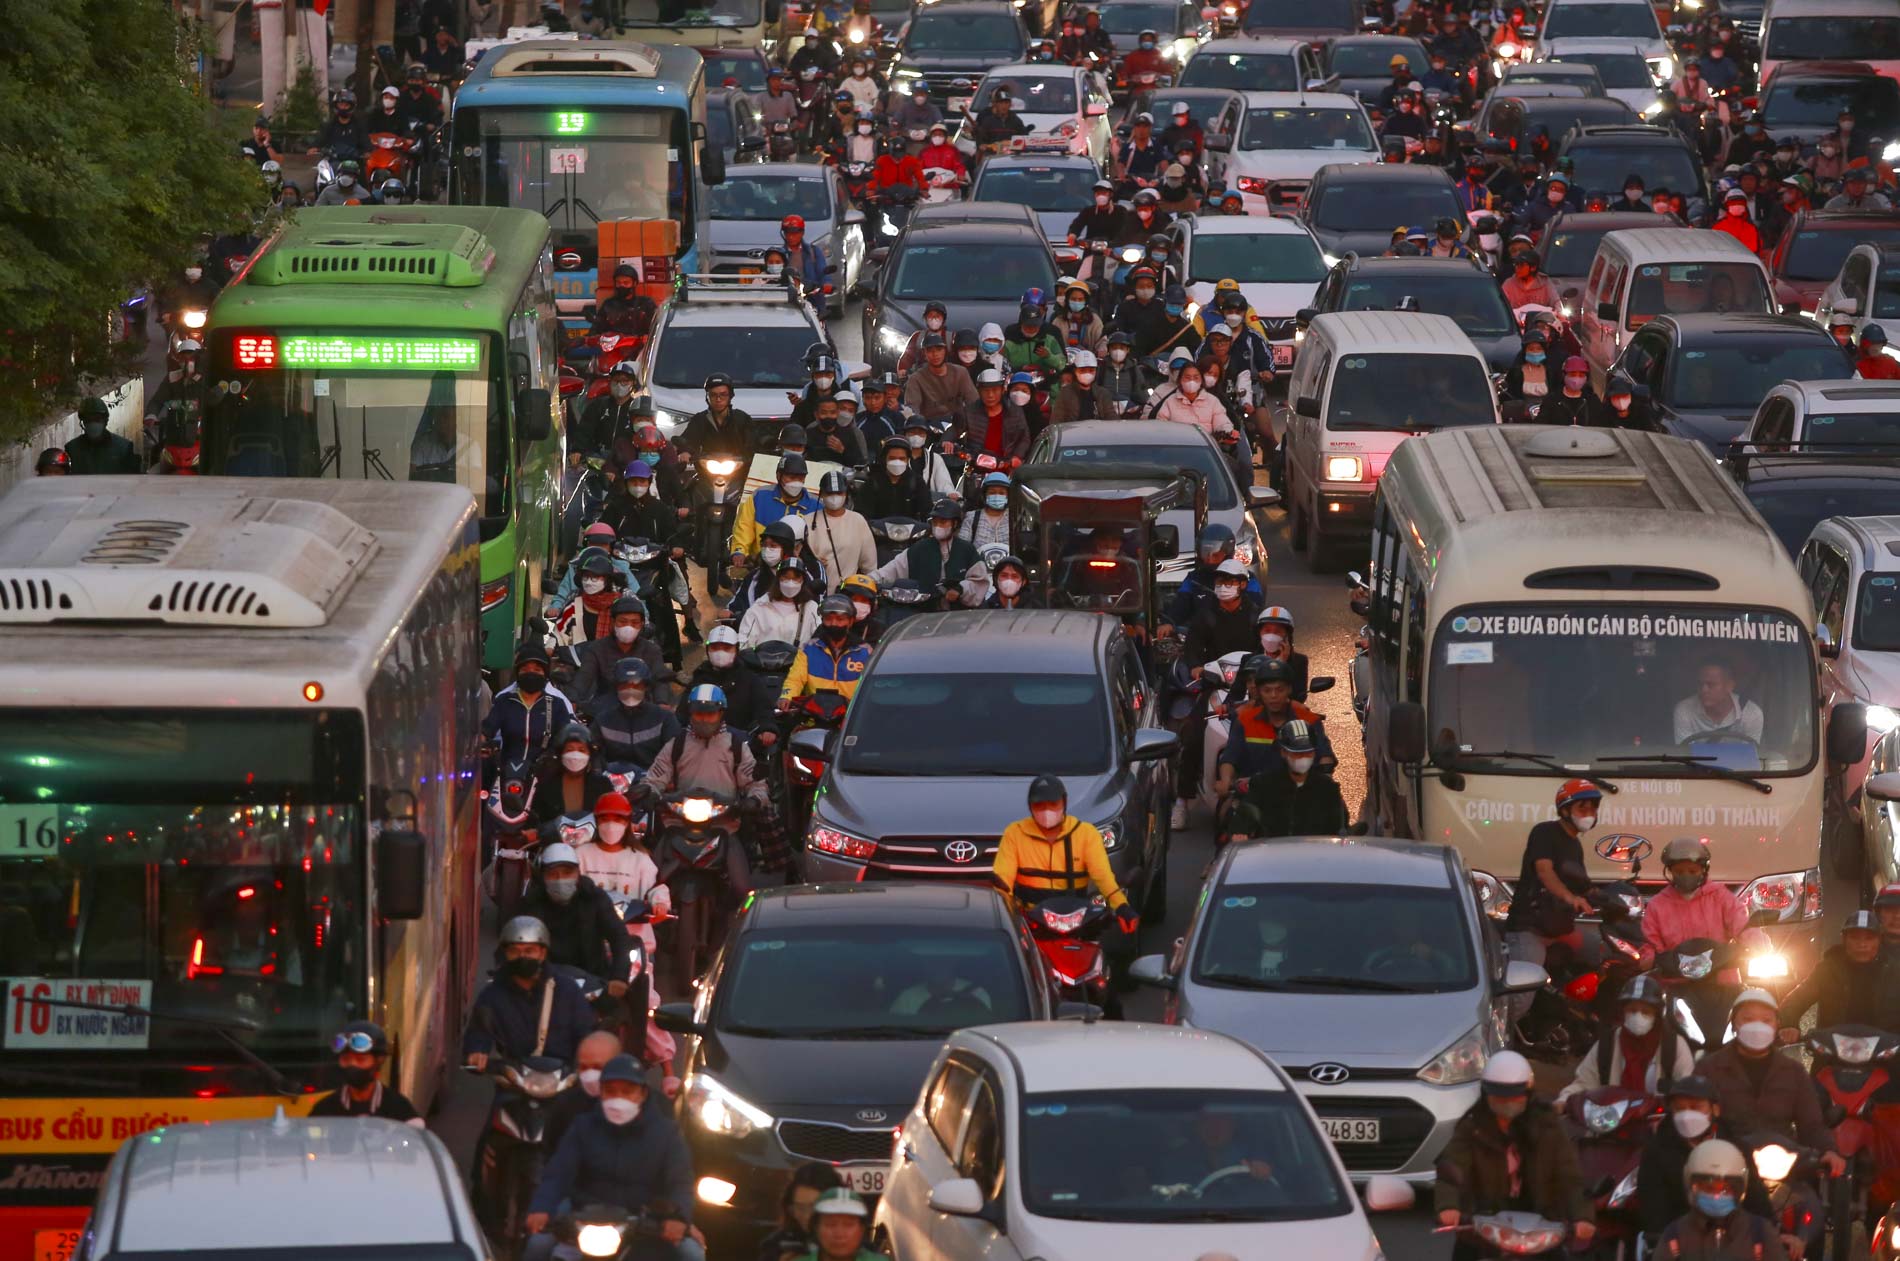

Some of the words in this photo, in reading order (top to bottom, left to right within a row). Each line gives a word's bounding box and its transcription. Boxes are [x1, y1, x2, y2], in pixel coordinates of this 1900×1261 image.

[557, 153, 578, 169] 19
[1481, 616, 1505, 634] XE
[1507, 615, 1545, 635] ĐƯA
[1547, 614, 1585, 636] ĐÓN
[1587, 614, 1625, 636] CÁN
[1627, 614, 1651, 639] BỘ
[1654, 615, 1704, 638] CÔNG
[1706, 618, 1757, 640] NHÂN
[1758, 621, 1799, 643] VIÊN
[846, 657, 864, 672] be
[1622, 781, 1637, 793] XE
[1465, 799, 1514, 822] CÔNG
[1519, 803, 1543, 822] TY
[15, 816, 57, 849] 16
[11, 982, 52, 1036] 16
[56, 1014, 73, 1035] BX
[0, 1116, 45, 1141] BUS
[52, 1106, 104, 1141] CẦU
[845, 1171, 885, 1191] A-98
[56, 1232, 80, 1249] 29
